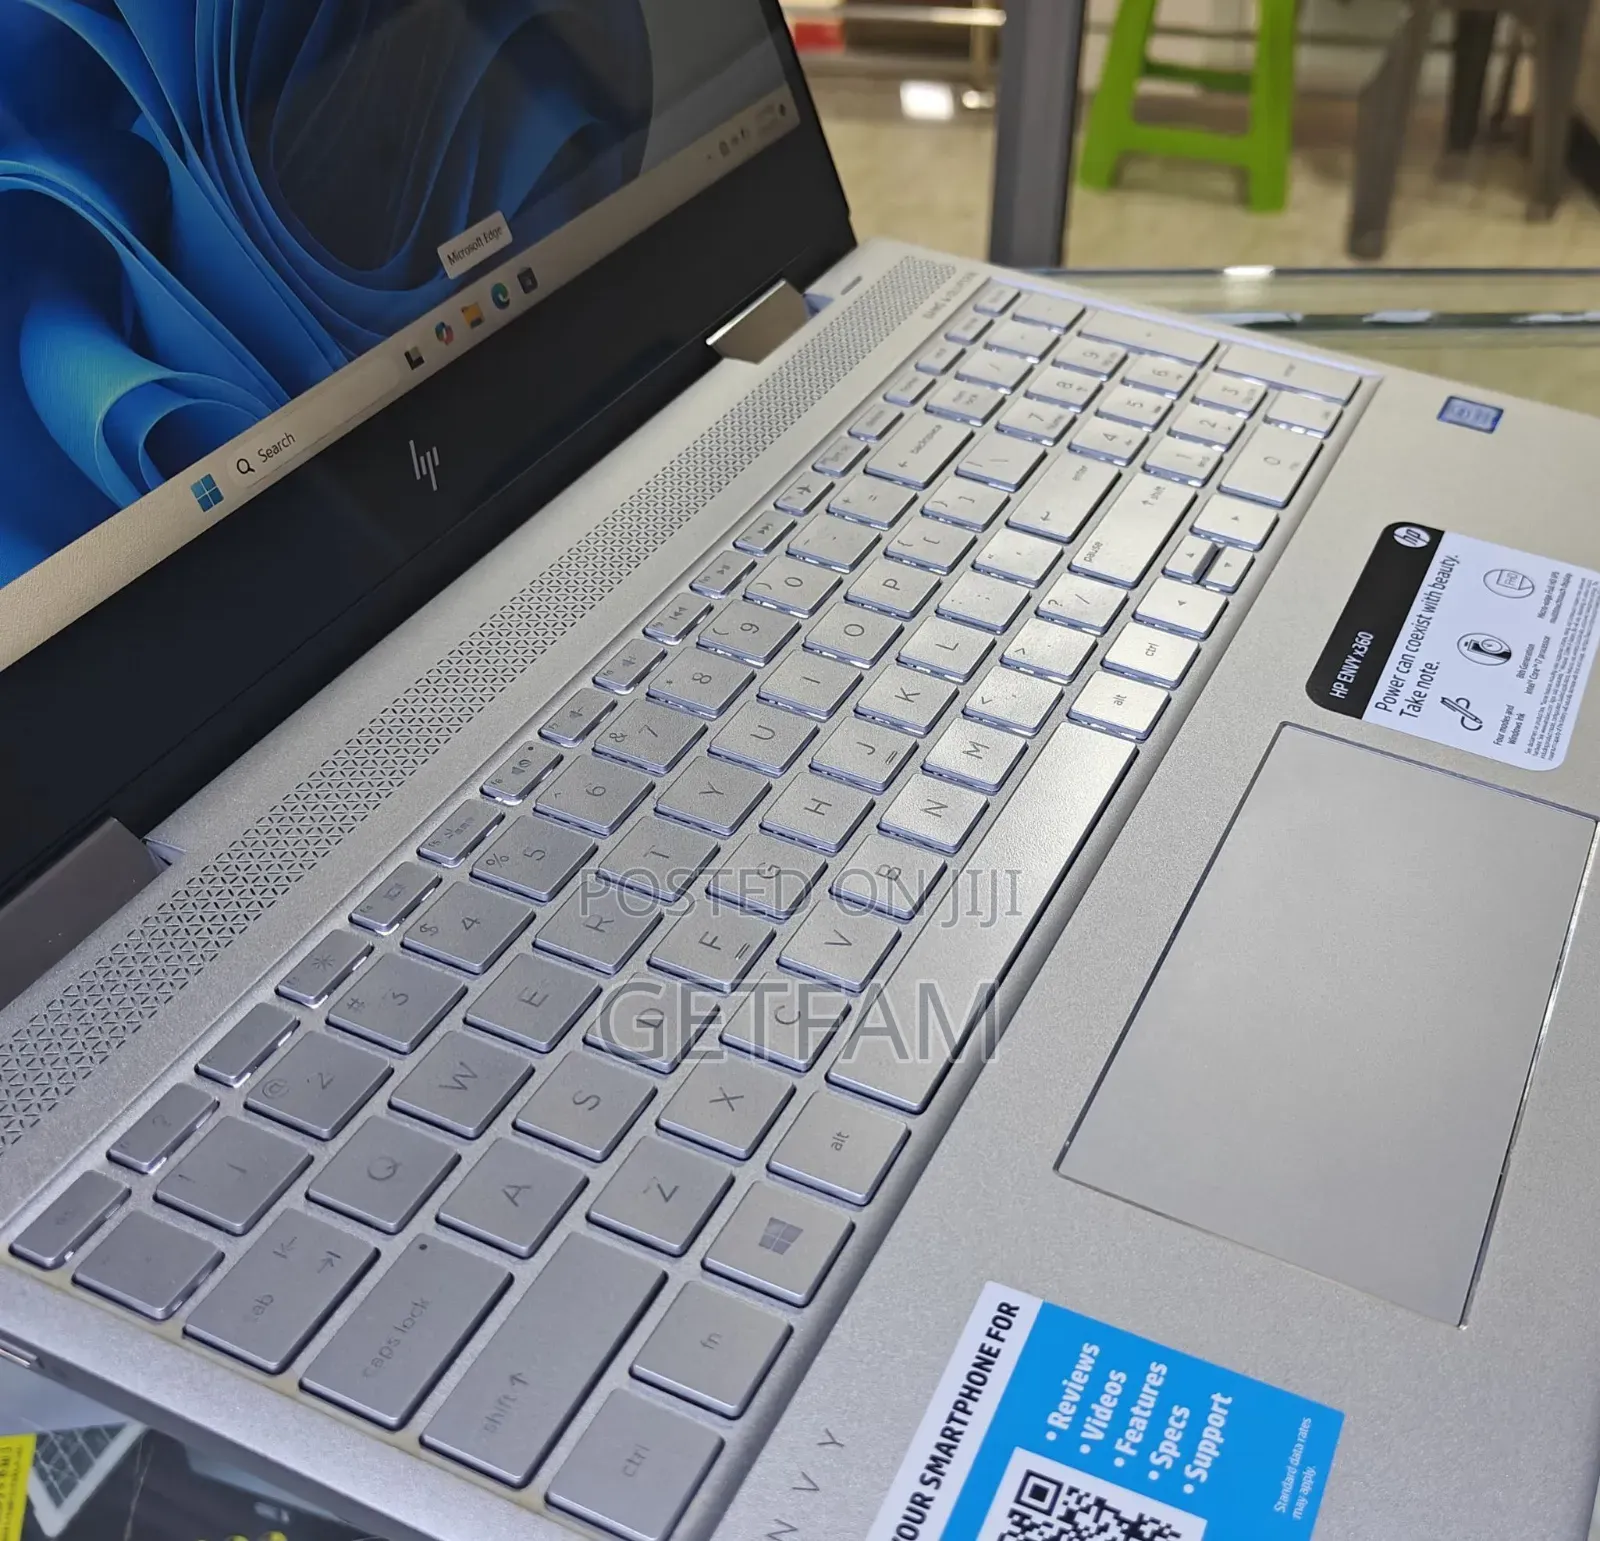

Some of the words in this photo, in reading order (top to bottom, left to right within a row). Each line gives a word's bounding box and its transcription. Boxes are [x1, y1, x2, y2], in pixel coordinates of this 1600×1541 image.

[447, 236, 484, 266] Microsoft
[1126, 399, 1144, 409] 5
[1028, 411, 1045, 423] 7
[1199, 419, 1217, 428] 2
[257, 432, 296, 463] Search
[1103, 432, 1119, 442] 4
[1084, 541, 1104, 563] pause
[1428, 554, 1460, 592] beauty.
[882, 578, 900, 591] P
[1421, 588, 1442, 616] with
[739, 622, 760, 634] 9
[843, 623, 865, 637] O
[1405, 614, 1432, 653] coexist
[1145, 642, 1160, 657] ctrl
[1352, 631, 1374, 658] x360
[1337, 655, 1362, 684] ENVY
[1396, 653, 1416, 675] can
[692, 672, 713, 685] 8
[1399, 690, 1428, 718] Take
[1416, 661, 1441, 690] note.
[894, 687, 921, 703] K
[1113, 694, 1127, 707] alt
[1329, 682, 1349, 699] HP
[1374, 674, 1406, 713] Power
[638, 724, 659, 738] 7
[750, 724, 776, 741] U
[856, 741, 876, 756] J
[962, 740, 990, 760] M
[585, 784, 606, 797] 6
[699, 781, 724, 796] Y
[803, 798, 833, 816] H
[920, 798, 949, 818] N
[523, 848, 546, 862] 5
[642, 844, 670, 859] T
[756, 862, 782, 880] G
[875, 863, 902, 881] B
[461, 916, 481, 932] 4
[583, 914, 615, 933] R
[698, 930, 722, 951] F
[824, 929, 852, 947] V
[518, 986, 549, 1008] E
[636, 1007, 665, 1029] D
[774, 1005, 801, 1025] C
[306, 1071, 335, 1091] 2
[438, 1061, 479, 1091] W
[571, 1089, 602, 1111] S
[709, 1086, 745, 1112] X
[831, 1130, 850, 1152] alt
[367, 1156, 401, 1182] Q
[502, 1183, 534, 1208] A
[643, 1176, 680, 1203] Z
[362, 1336, 401, 1379] caps
[392, 1297, 430, 1334] lock
[699, 1331, 724, 1350] fn
[1047, 1342, 1101, 1431] Reviews
[484, 1391, 518, 1434] shift
[1080, 1369, 1128, 1441] Videos
[1114, 1361, 1168, 1457] Features
[891, 1491, 935, 1541] OUR
[919, 1343, 1001, 1491] SMARTPHONE
[985, 1301, 1021, 1343] FOR
[1149, 1404, 1191, 1470] Specs
[1184, 1392, 1233, 1483] Support
[622, 1442, 650, 1479] ctrl
[1273, 1465, 1298, 1514] Standard
[1288, 1442, 1305, 1467] data
[1298, 1416, 1312, 1443] rates
[1299, 1465, 1317, 1495] apply.
[1292, 1495, 1309, 1520] may
